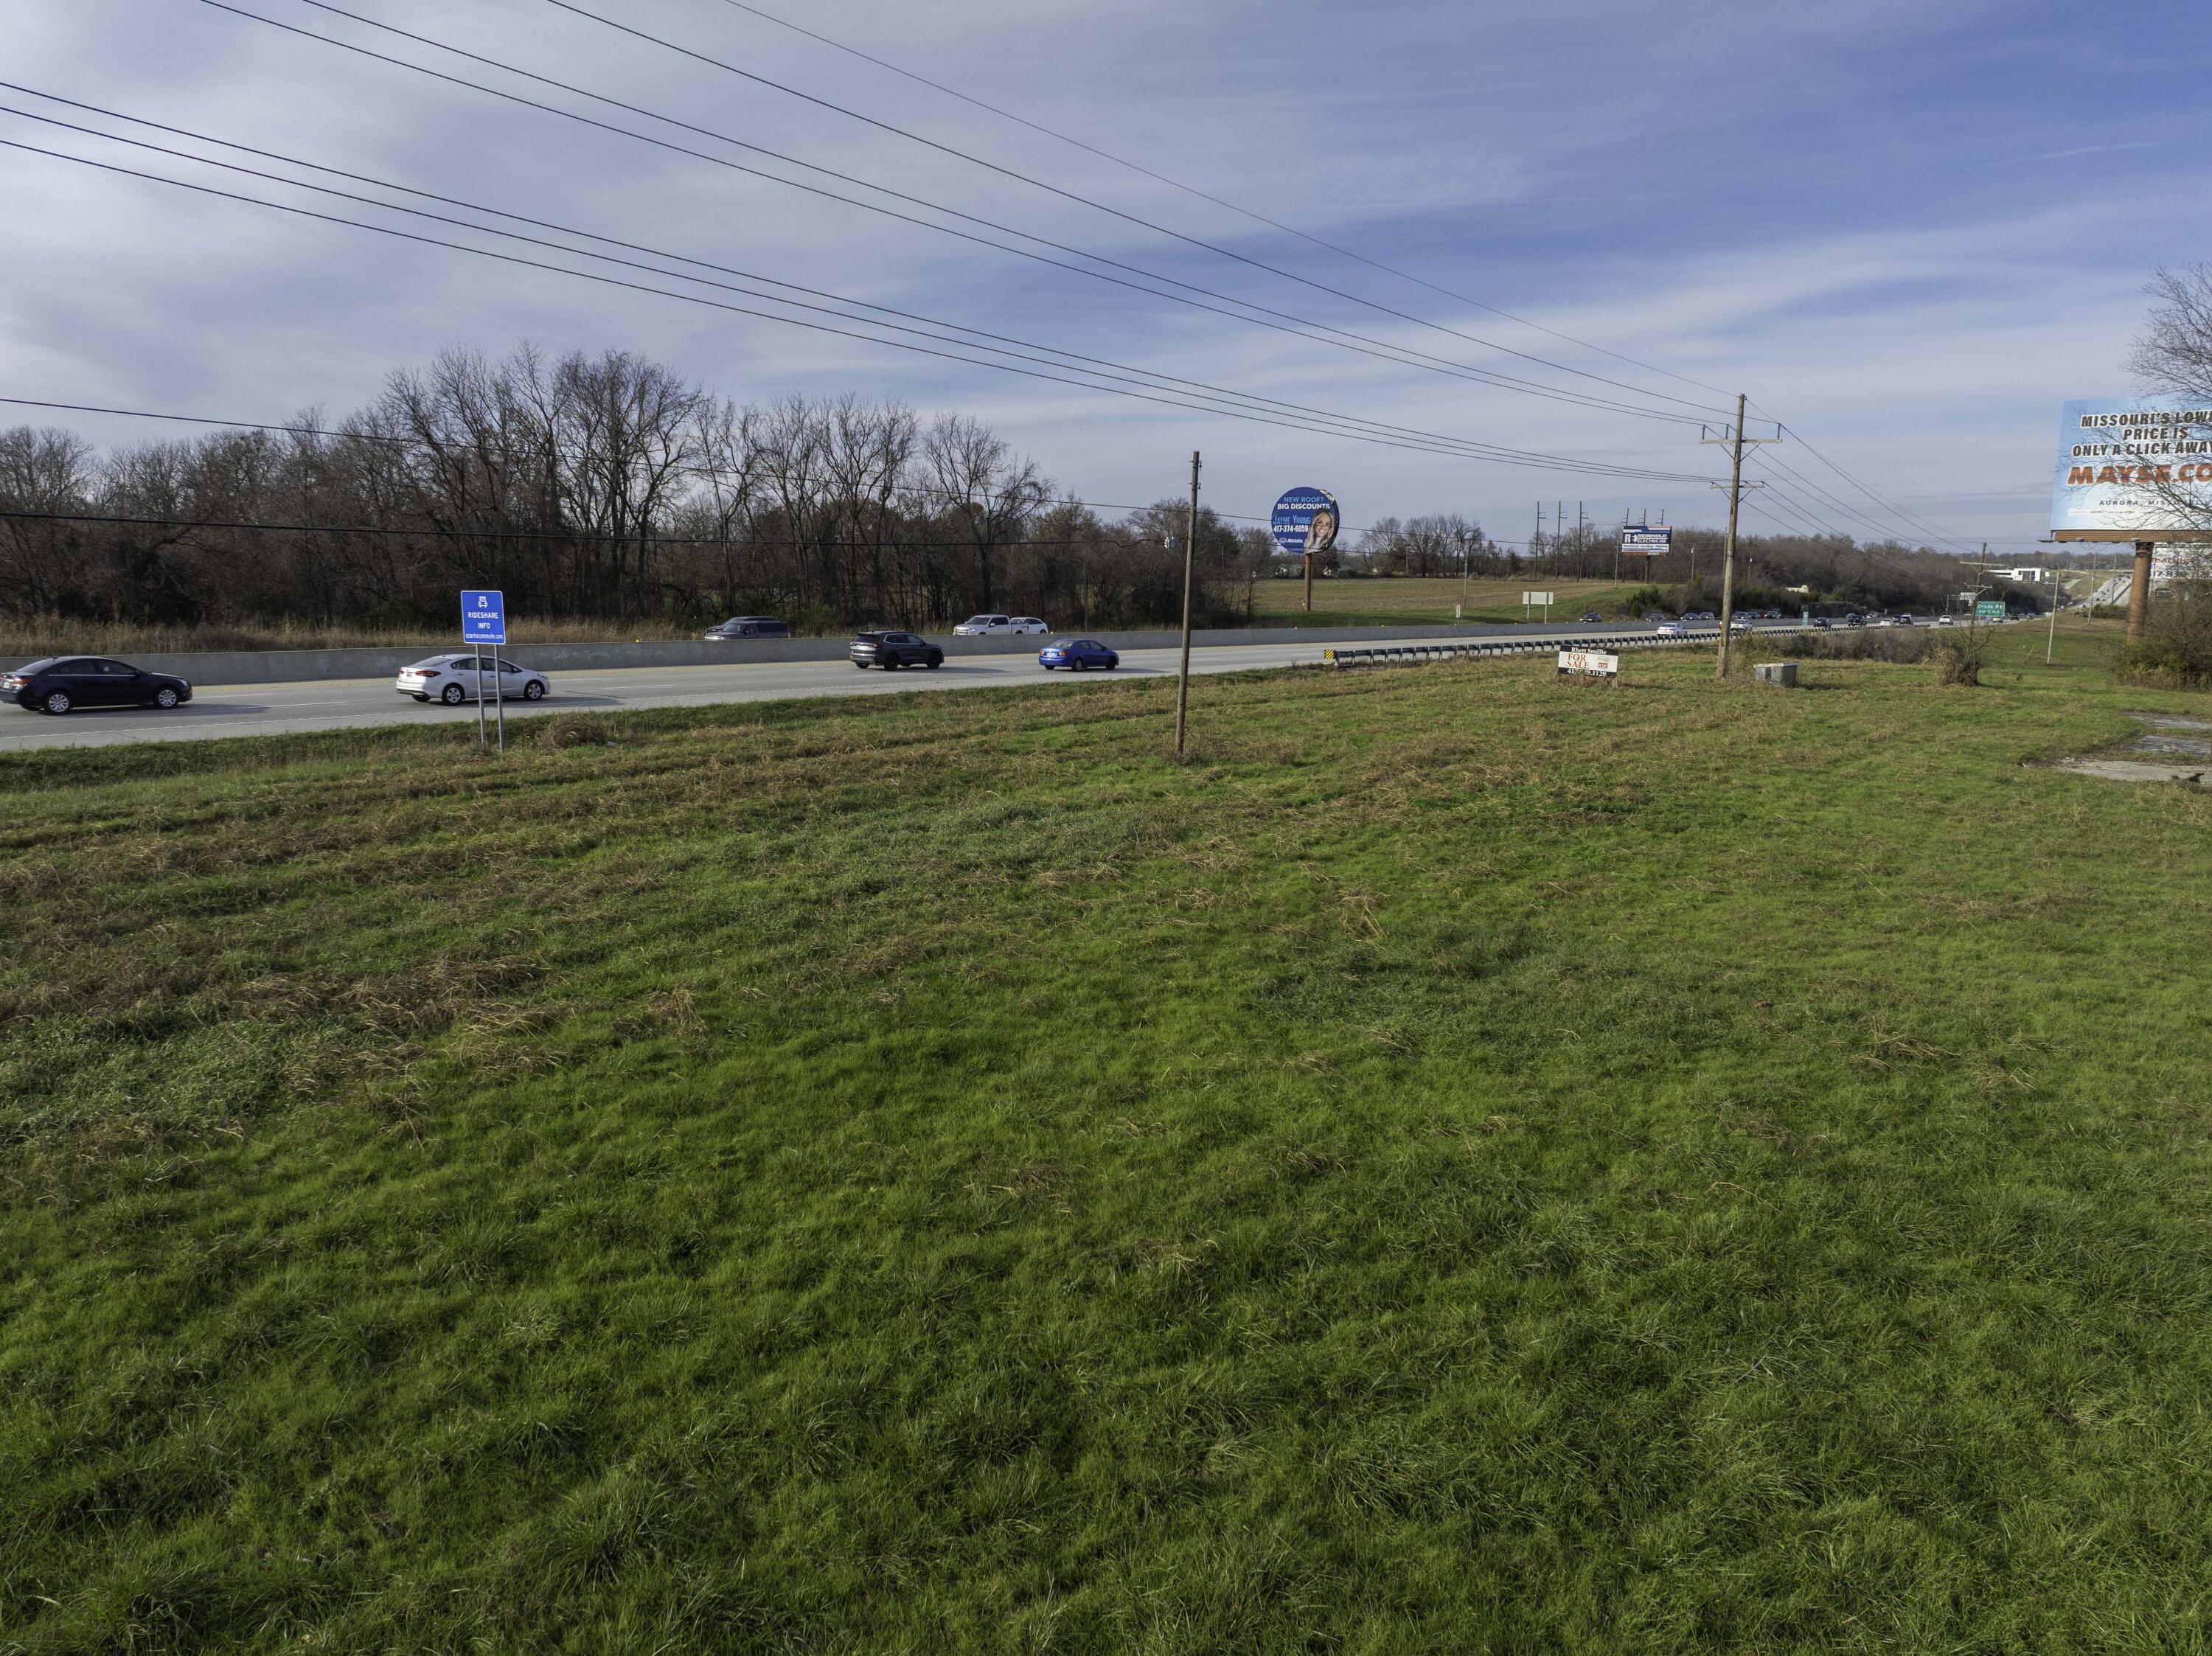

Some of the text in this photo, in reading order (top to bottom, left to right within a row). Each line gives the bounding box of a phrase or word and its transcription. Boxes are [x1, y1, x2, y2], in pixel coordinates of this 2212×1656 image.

[2081, 412, 2170, 427] MISSOURI'S
[2124, 427, 2188, 440] PRICE IS
[2073, 444, 2108, 456] ONLY
[2112, 444, 2121, 456] A
[2126, 442, 2170, 455] CLICK
[1568, 653, 1586, 661] FOR
[1567, 661, 1589, 669] SALE
